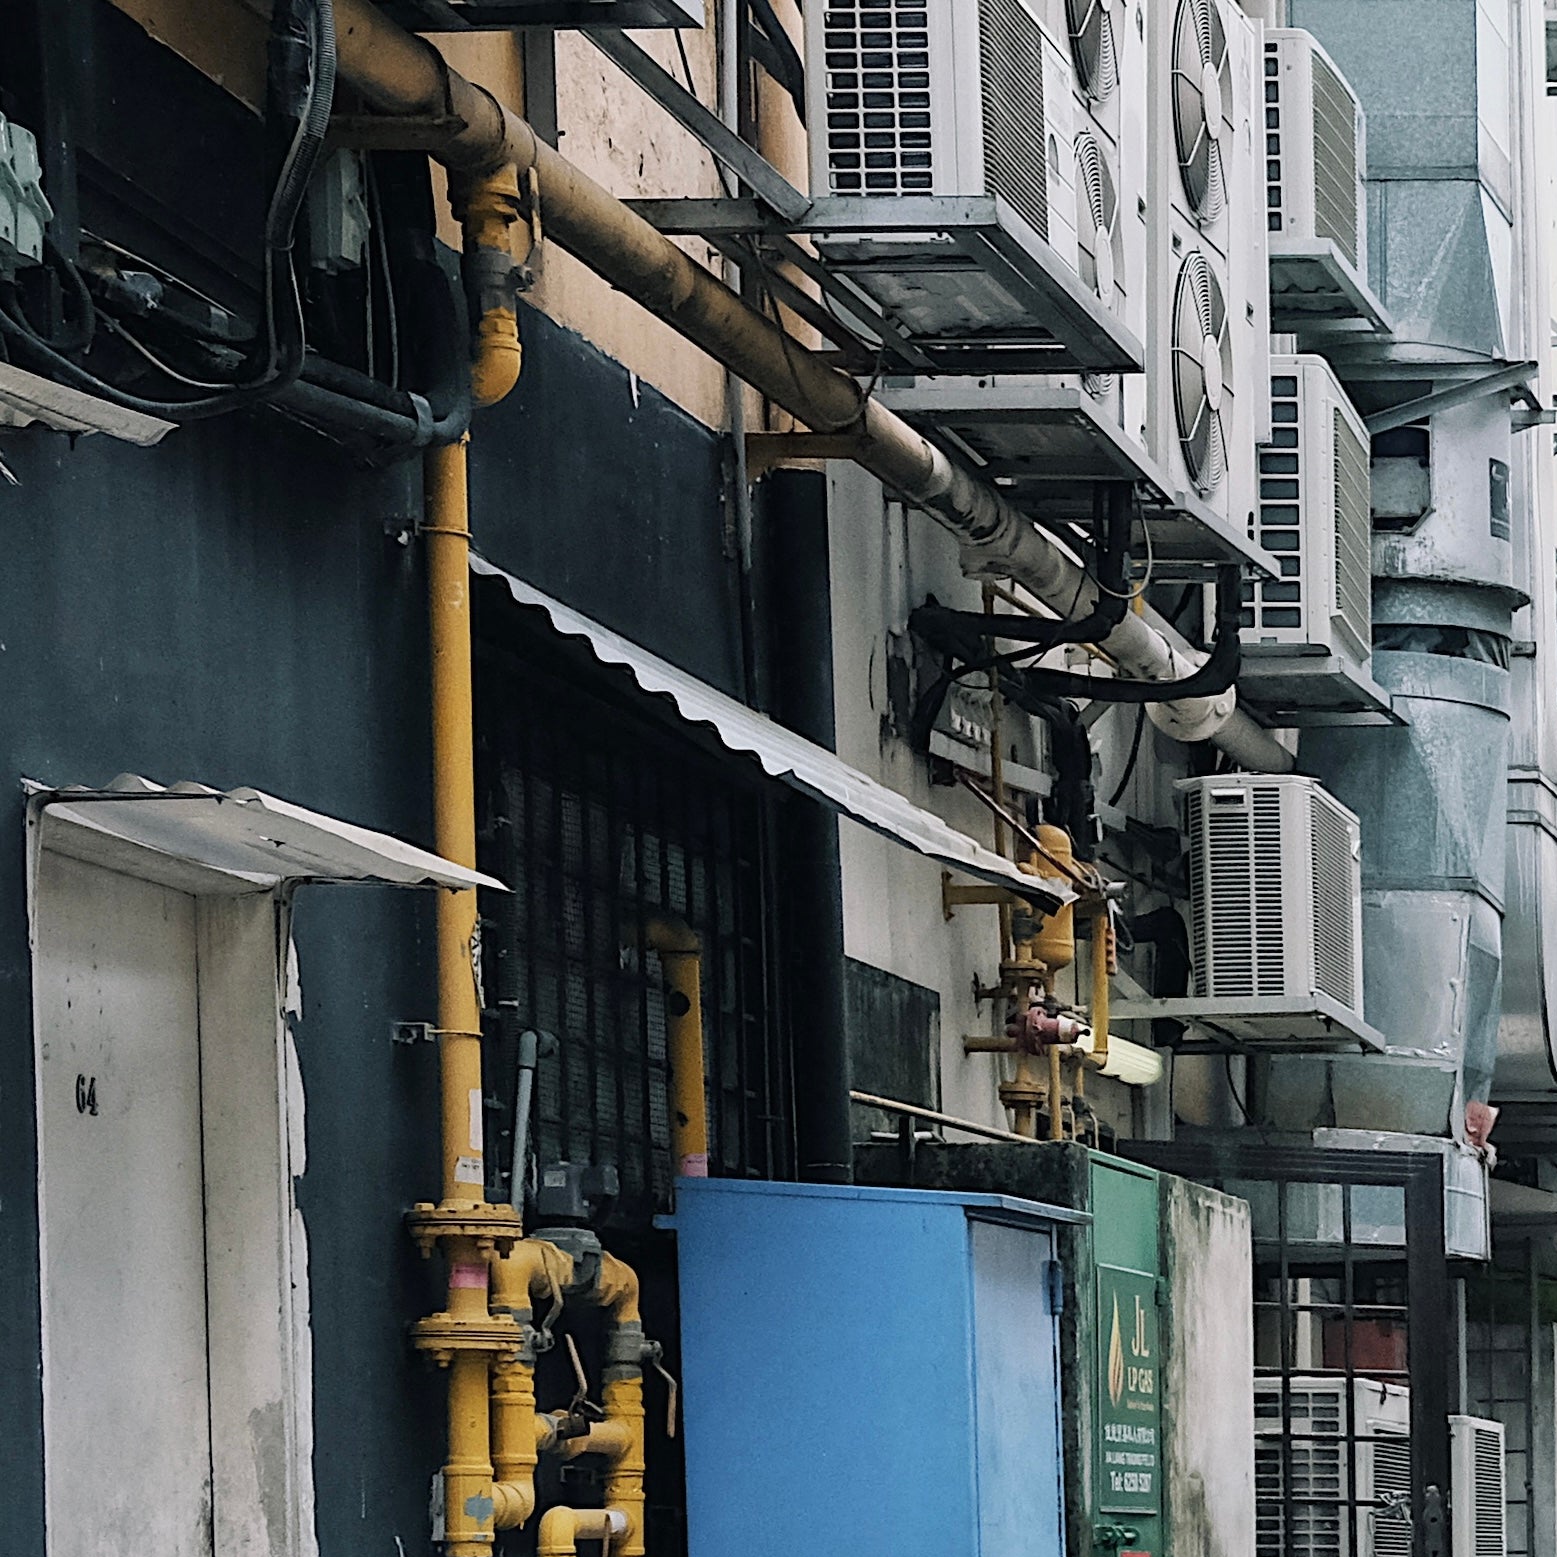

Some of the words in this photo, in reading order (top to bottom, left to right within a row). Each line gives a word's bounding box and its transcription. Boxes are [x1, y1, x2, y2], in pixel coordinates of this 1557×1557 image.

[75, 1073, 99, 1116] 64
[1131, 1295, 1150, 1358] JL
[1127, 1366, 1138, 1392] LP
